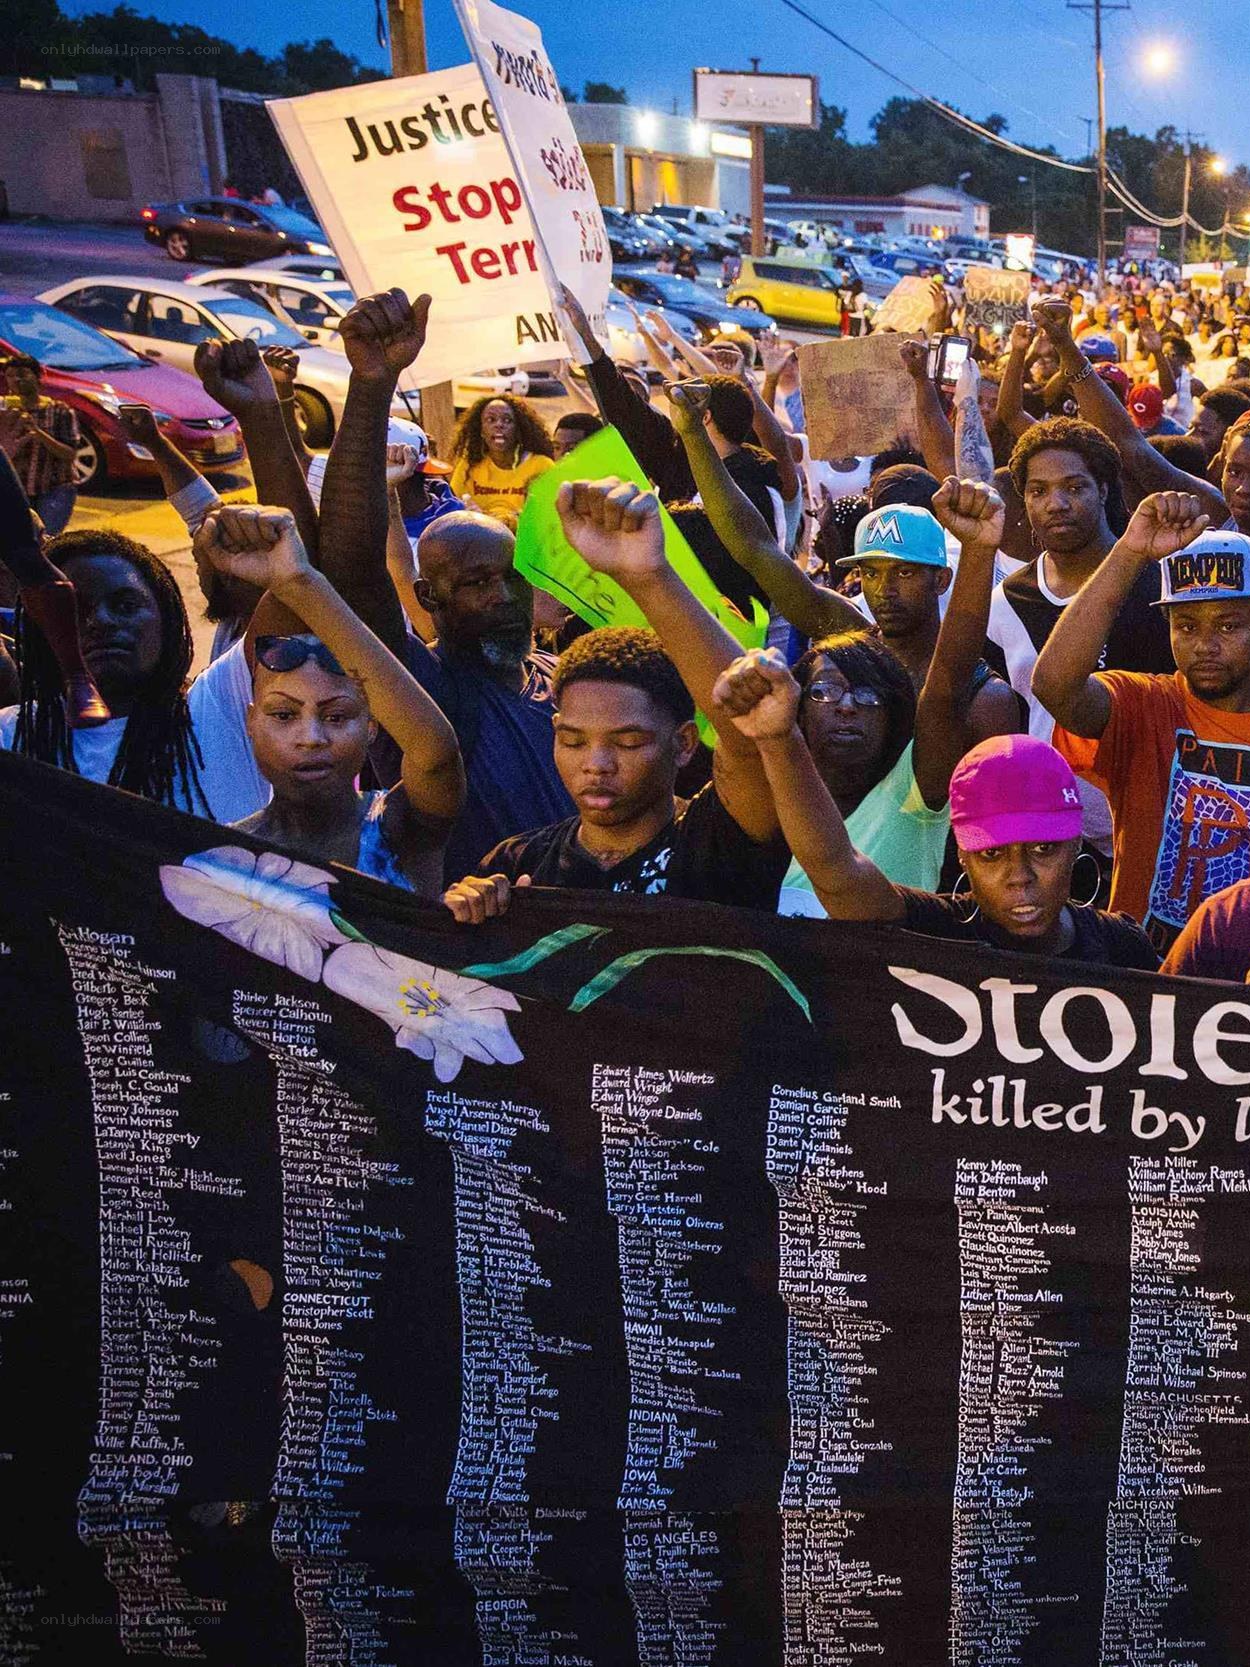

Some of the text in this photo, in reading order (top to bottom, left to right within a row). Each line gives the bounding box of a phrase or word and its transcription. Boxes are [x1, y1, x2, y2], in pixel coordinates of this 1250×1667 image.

[344, 95, 501, 162] Justice
[392, 177, 522, 232] Stop
[1167, 552, 1244, 595] MEMPHIS
[79, 928, 135, 946] Hogan
[233, 990, 320, 1010] Shirley Jackson
[279, 1007, 332, 1023] Calhoun
[593, 1064, 631, 1077] Edward
[635, 1067, 664, 1080] James
[592, 1077, 672, 1094] Edward Wright
[772, 1084, 902, 1109] Cornelius Garland Smith
[94, 1103, 179, 1117] Kenny Johnson
[427, 1091, 541, 1118] Fred Lawrence Murray
[770, 1098, 849, 1115] Damian Garcia
[930, 1067, 1106, 1137] killed
[1130, 1081, 1207, 1154] by
[94, 1113, 173, 1128] Kevin Morris
[769, 1110, 847, 1127] Daniel Collins
[95, 1126, 200, 1148] LaTanya Haggerty
[957, 1158, 1022, 1173] Kenny Moore
[1130, 1156, 1198, 1170] Tyisha Miller
[1128, 1166, 1245, 1184] William Anthony Ramos
[954, 1184, 1016, 1198] Kim Benton
[1127, 1179, 1166, 1193] William
[1170, 1180, 1215, 1193] Edward
[1132, 1205, 1199, 1219] LOUISIANA
[456, 1229, 535, 1251] Joey Summerlin
[779, 1268, 868, 1283] Eduardo Ramirez
[1132, 1273, 1175, 1284] MAINE
[283, 1293, 371, 1307] CONNECTICUT
[960, 1287, 1063, 1302] Luther Thomas Allen
[283, 1332, 330, 1345] FLORIDA
[1124, 1390, 1243, 1404] MASSACHUSETTS
[629, 1409, 678, 1423] INDIANA
[162, 1455, 193, 1467] OHIO
[623, 1470, 657, 1482] IOWA
[616, 1497, 667, 1511] KANSAS
[1107, 1500, 1175, 1511] MICHIGAN
[625, 1531, 718, 1546] LOS ANGELES
